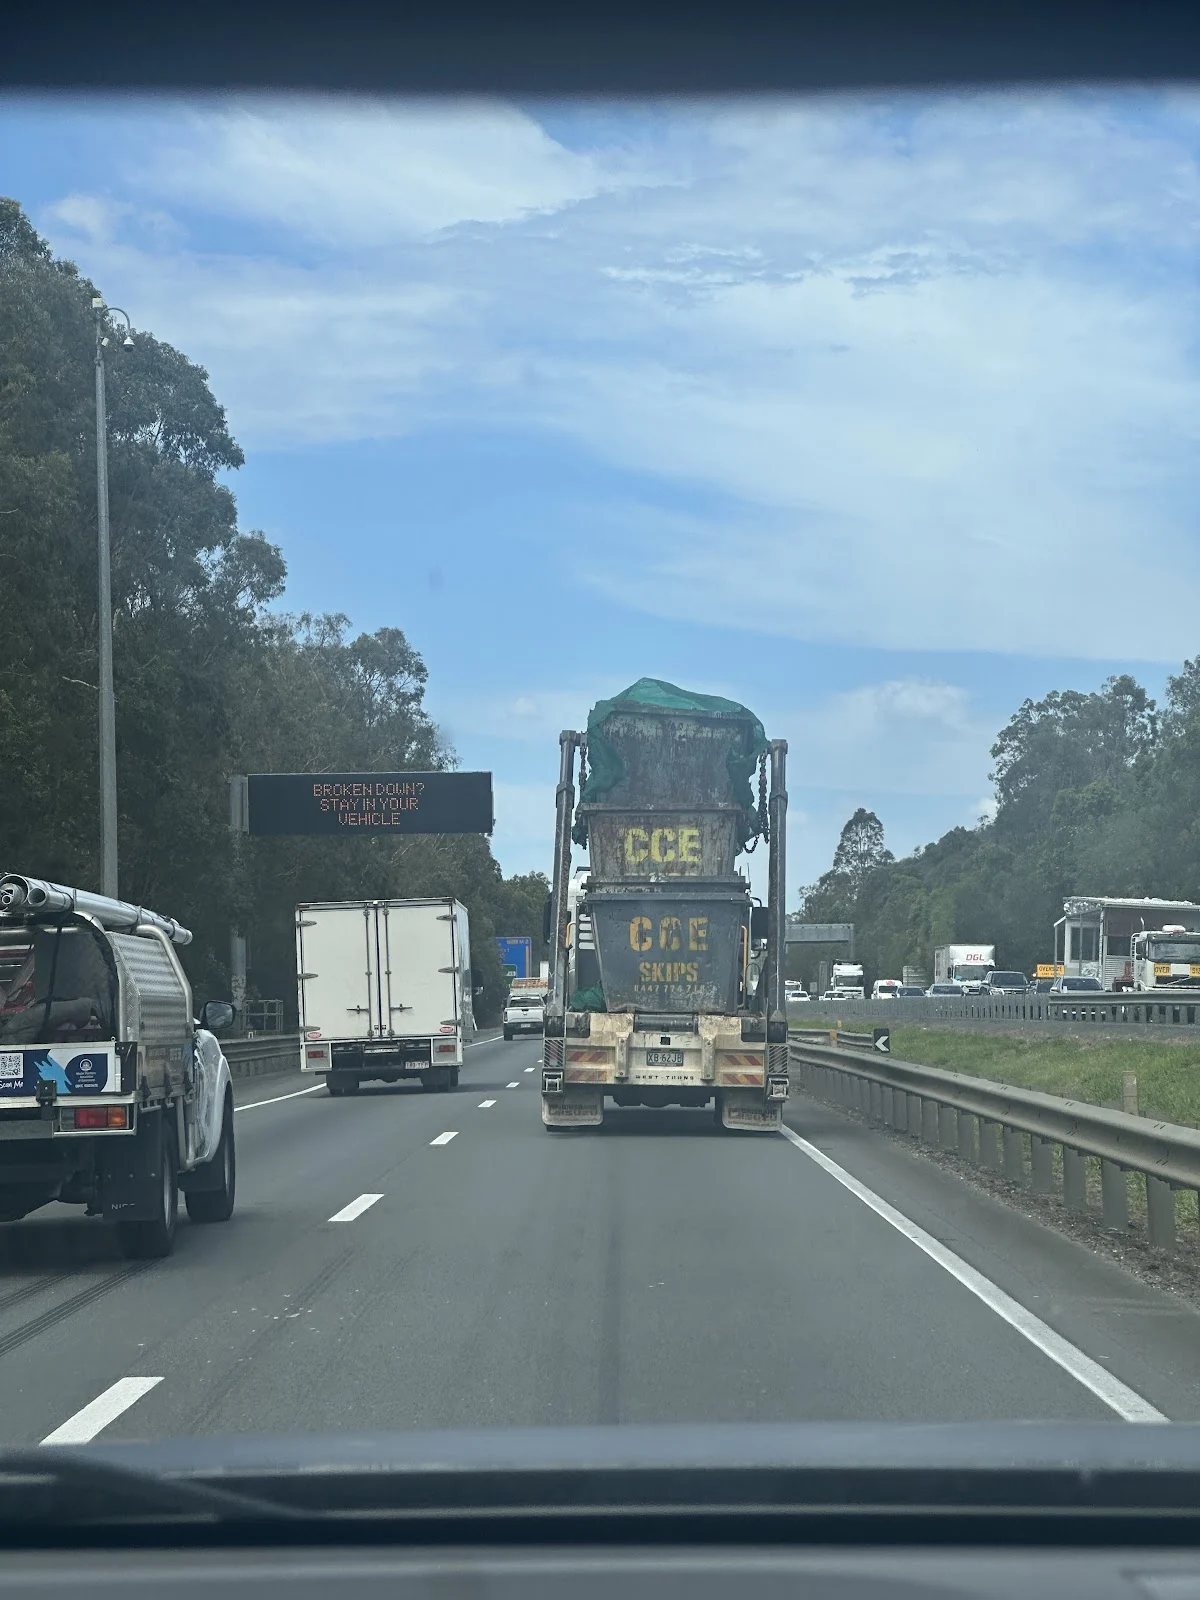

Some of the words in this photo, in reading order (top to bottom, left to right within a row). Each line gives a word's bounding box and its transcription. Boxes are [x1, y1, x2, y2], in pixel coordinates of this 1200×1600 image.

[313, 783, 372, 797] BROKEN
[375, 782, 425, 796] DOWN?
[320, 798, 359, 811] STAY
[362, 798, 376, 811] IN
[379, 797, 419, 811] YOUR
[338, 812, 401, 826] VEHICLE
[623, 828, 701, 863] CCE
[629, 916, 708, 951] CCE
[965, 953, 985, 961] DGL
[639, 962, 699, 982] SKIPS
[1038, 965, 1063, 973] OVERSZE
[1155, 966, 1170, 974] OVER
